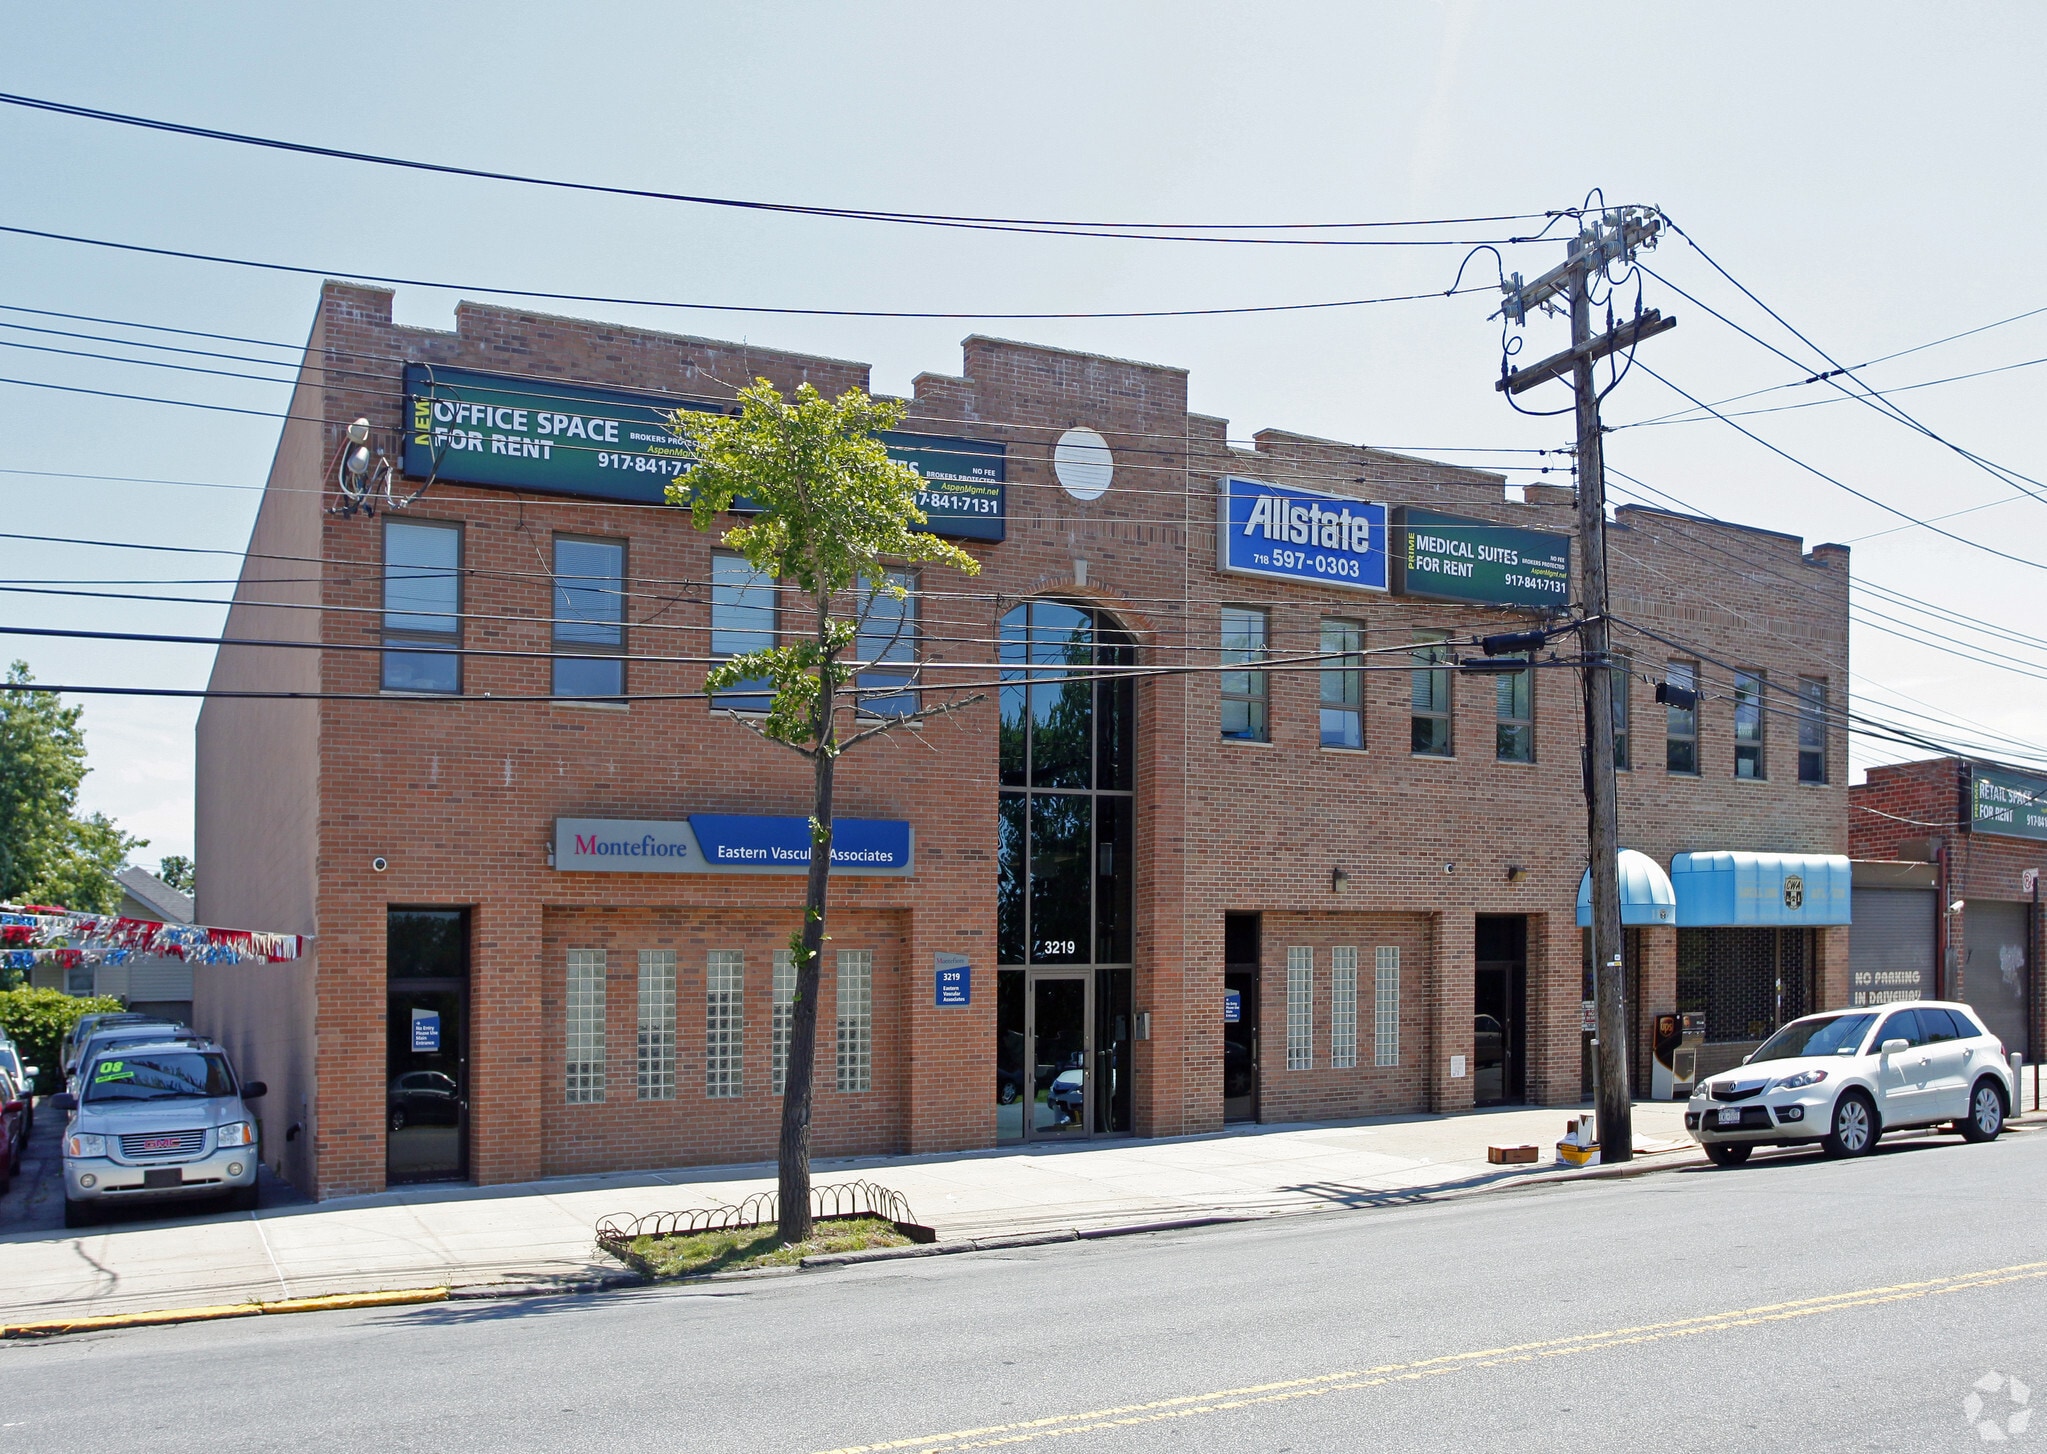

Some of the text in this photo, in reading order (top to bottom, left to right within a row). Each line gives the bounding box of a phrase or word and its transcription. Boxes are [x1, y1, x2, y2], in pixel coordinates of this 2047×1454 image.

[415, 399, 430, 445] NEW
[434, 401, 619, 443] OFFICE SPACE
[434, 426, 554, 460] FOR RENT
[630, 432, 666, 443] BROKERS
[926, 470, 957, 481] BROKERS
[972, 467, 996, 477] NO FEE
[1243, 494, 1369, 554] Allstate
[1416, 534, 1518, 566] MEDICAL SUITES
[1253, 548, 1360, 577] 718 597-0303
[1416, 555, 1474, 577] FOR RENT
[1980, 782, 2006, 802] RETAIL
[1980, 803, 2014, 823] FOR RENT
[575, 834, 893, 863] Montefiore Eastern Vascul Associates
[1044, 940, 1075, 954] 3219
[943, 973, 960, 981] 3219
[1855, 970, 1920, 986] NO PARKING
[1854, 991, 1866, 1006] IN
[100, 1061, 124, 1073] 08
[144, 1138, 181, 1149] GMC
